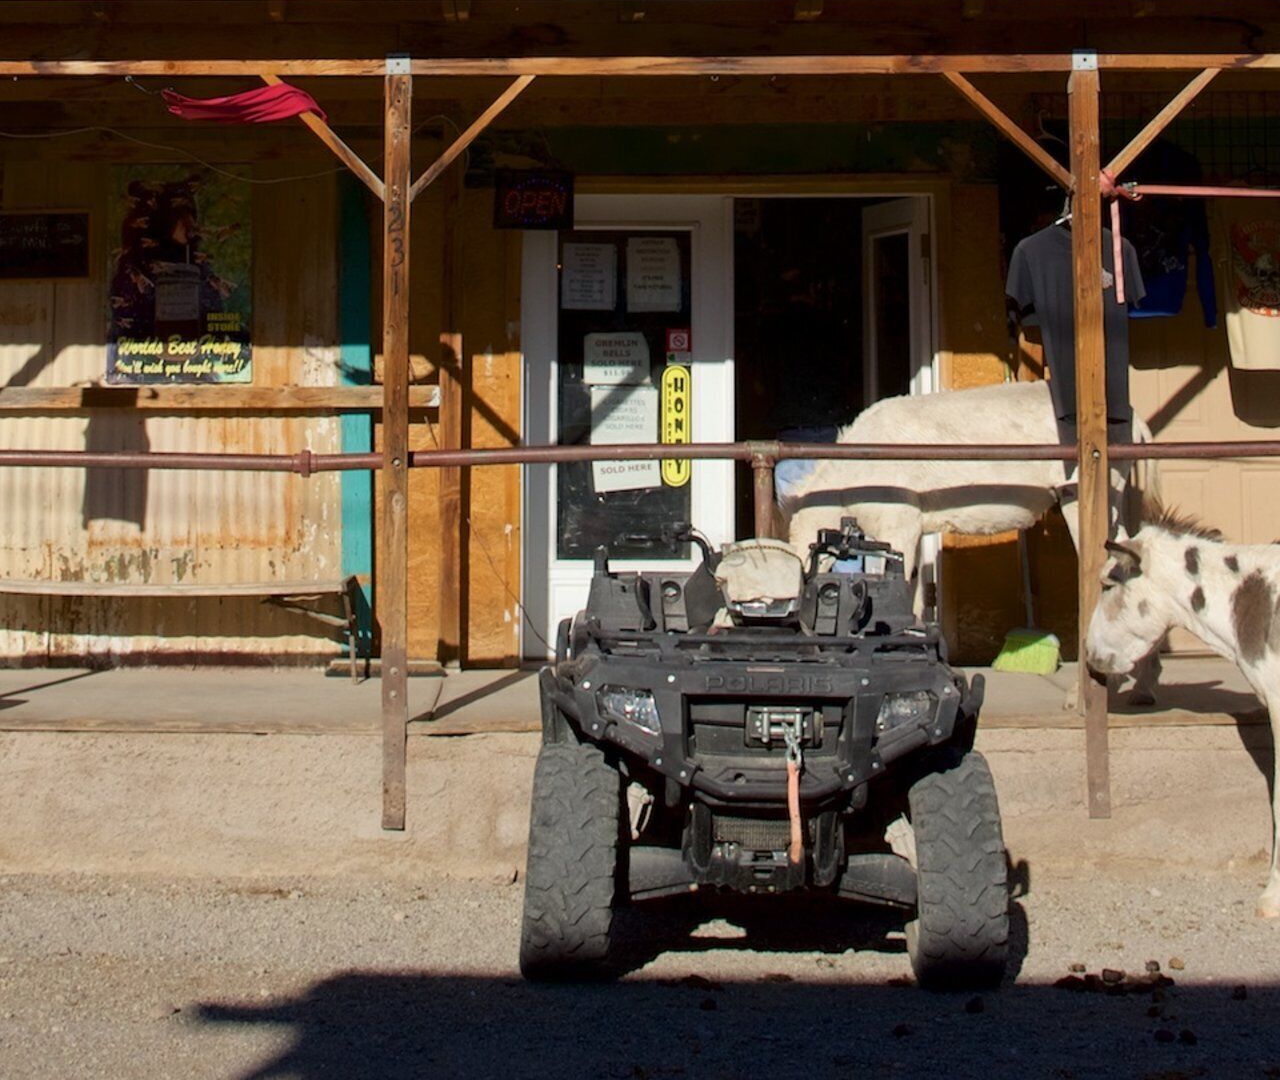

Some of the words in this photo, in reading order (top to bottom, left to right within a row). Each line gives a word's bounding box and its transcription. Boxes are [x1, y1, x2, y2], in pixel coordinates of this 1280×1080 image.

[504, 190, 565, 217] OPEN
[207, 312, 241, 321] INSIDE
[207, 322, 241, 332] STORE
[117, 336, 163, 355] Worlds
[167, 334, 198, 355] Best
[595, 339, 638, 348] GREMLIN
[603, 349, 631, 358] BELLS
[591, 359, 616, 368] SOLD
[618, 358, 643, 367] HERE
[600, 465, 625, 475] SOLD
[627, 462, 652, 472] HERE
[705, 675, 833, 694] POLARIS
